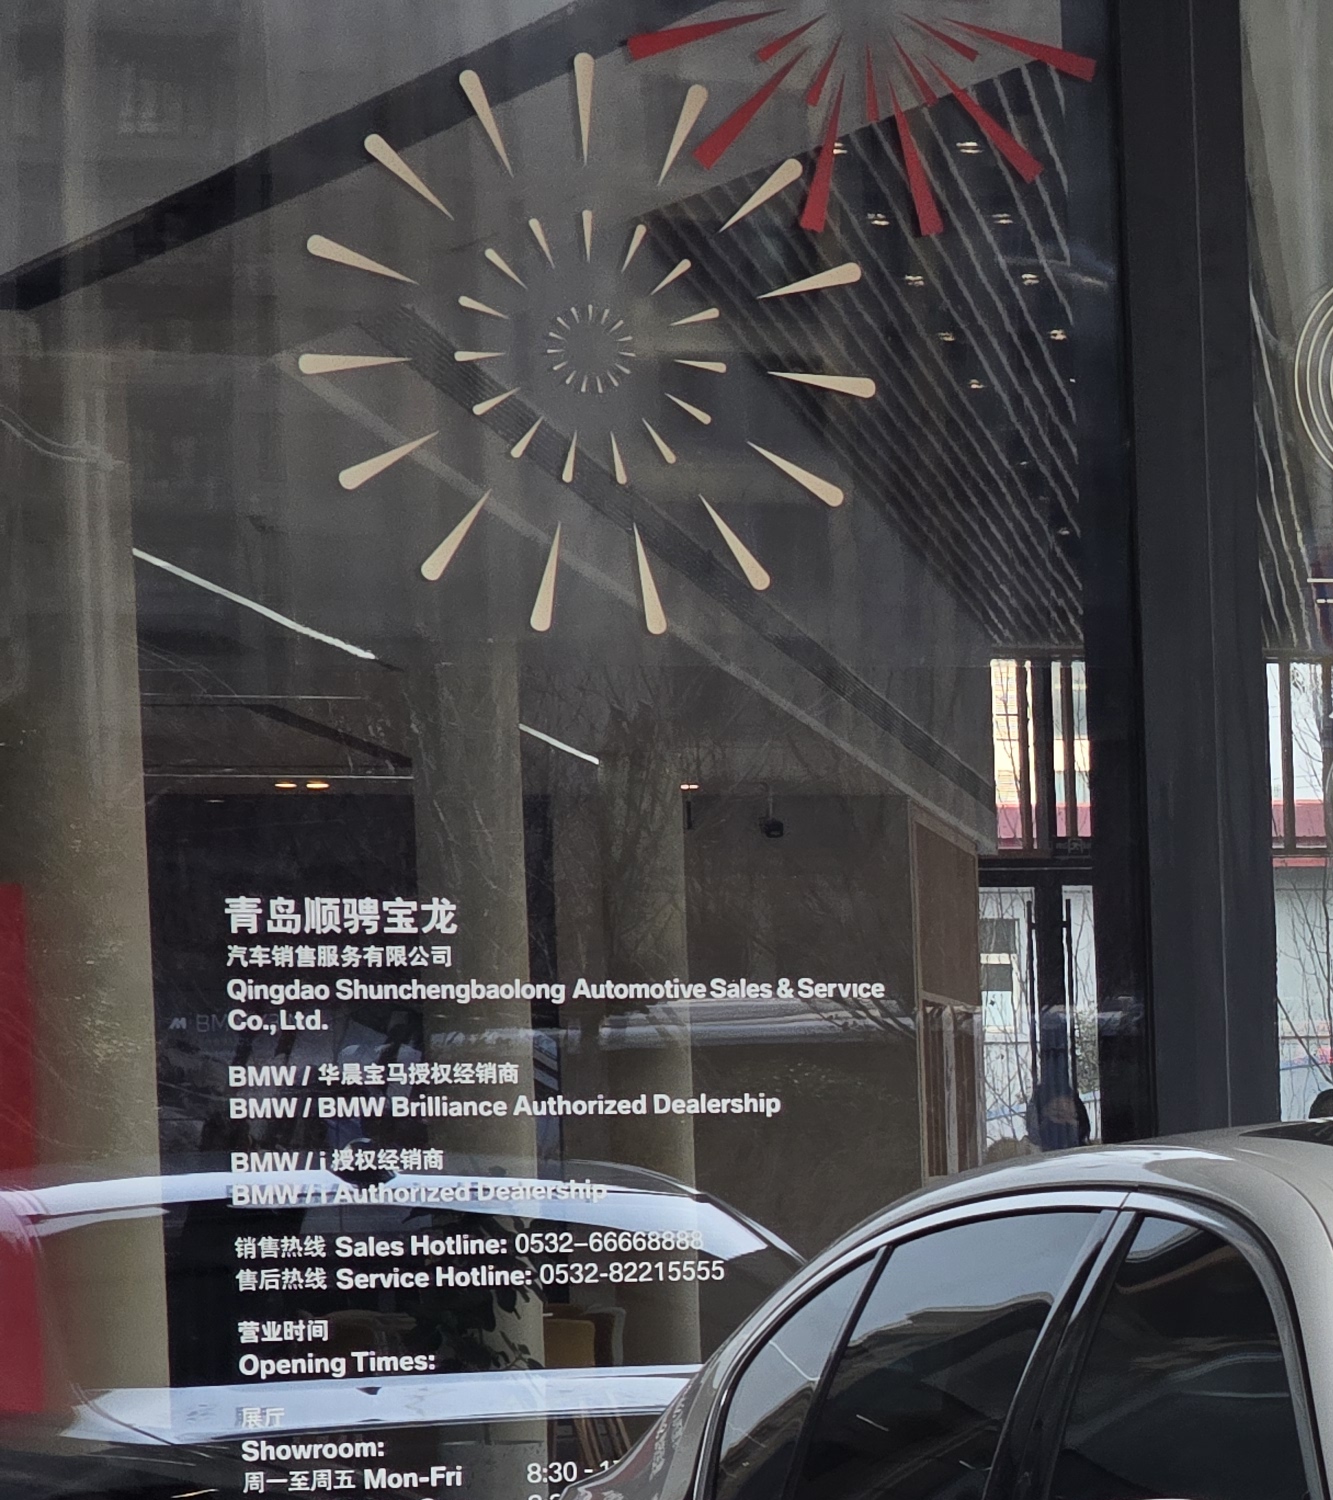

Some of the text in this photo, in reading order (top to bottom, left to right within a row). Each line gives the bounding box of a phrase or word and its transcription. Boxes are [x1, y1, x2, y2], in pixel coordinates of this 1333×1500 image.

[224, 895, 458, 935] 青岛顺骋宝龙
[226, 944, 452, 968] 汽车销售服务有限公司
[226, 977, 886, 1003] Qingdao Shunchengbaolong Automotive Sales & Service
[228, 1065, 297, 1087] BMW
[318, 1061, 520, 1086] 华晨宝马授权经销商
[229, 1097, 298, 1119] BMW
[317, 1096, 386, 1118] BMW
[391, 1093, 508, 1117] Brilliance
[512, 1093, 647, 1116] Authorized
[653, 1092, 781, 1118] Dealership
[230, 1152, 300, 1174] BMW
[331, 1146, 444, 1173] 授权经销商
[231, 1185, 302, 1206] BMW
[334, 1181, 471, 1204] Authorized
[477, 1179, 608, 1205] Dealership
[234, 1234, 327, 1260] 销售热线
[335, 1235, 405, 1258] Sales
[410, 1234, 508, 1256] Hotline:
[235, 1260, 725, 1292] 售后热线 Service Hotline: 0532-82215555
[237, 1319, 329, 1344] 营业时间
[238, 1350, 437, 1379] Opening Times:
[240, 1406, 286, 1430] 展厅
[241, 1440, 385, 1462] Showroom:
[242, 1468, 356, 1494] 周一至周五
[363, 1465, 463, 1490] Mon-Fri
[526, 1461, 579, 1485] 8:30
